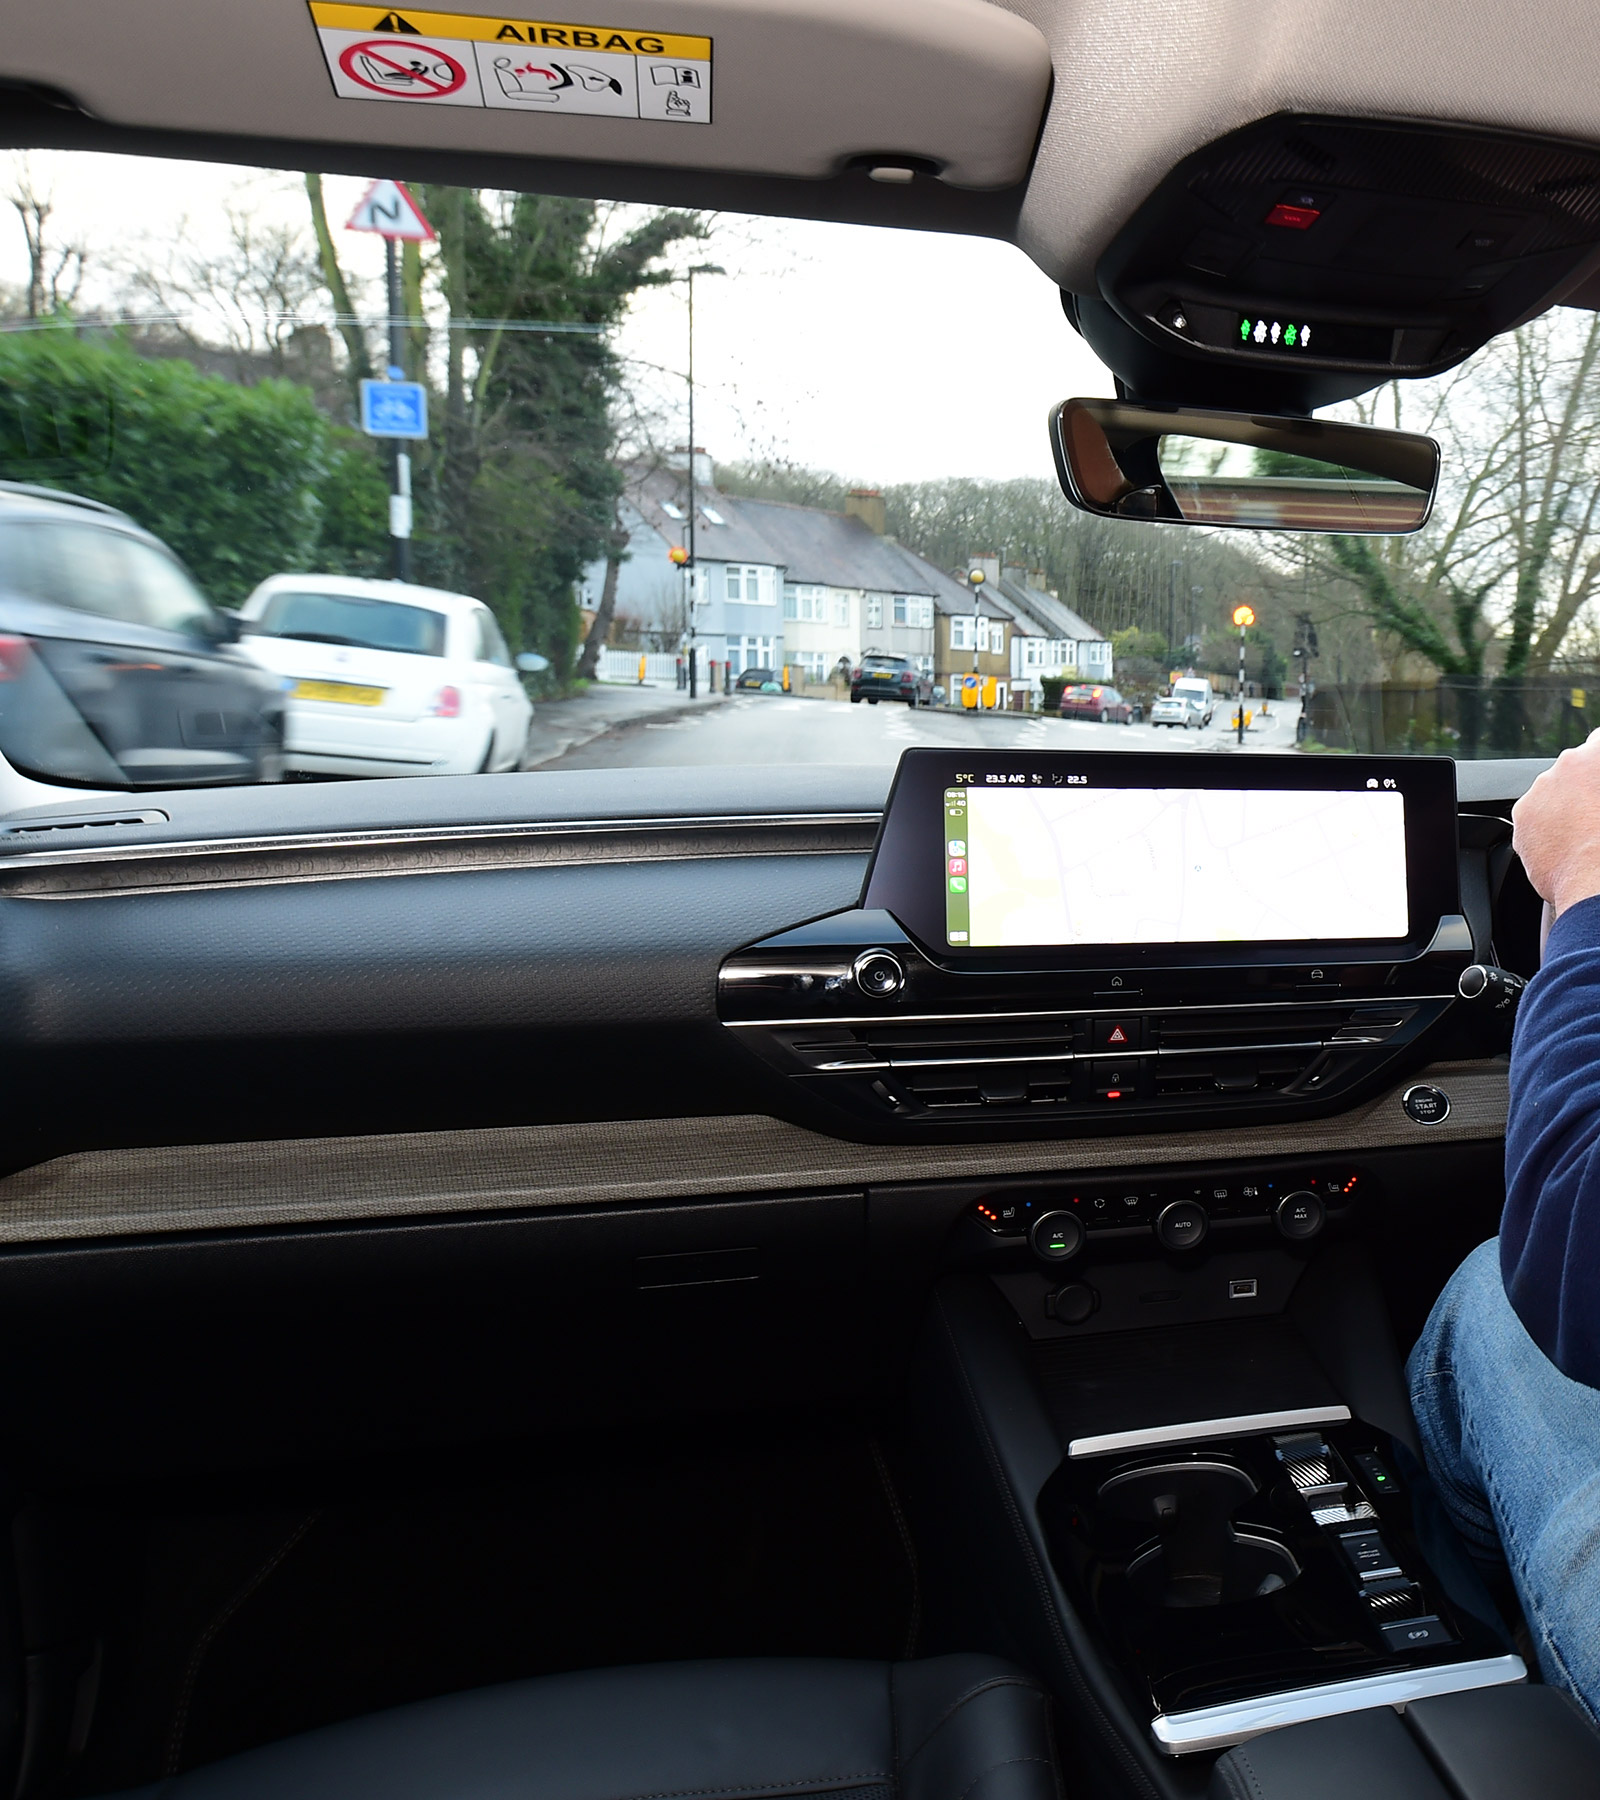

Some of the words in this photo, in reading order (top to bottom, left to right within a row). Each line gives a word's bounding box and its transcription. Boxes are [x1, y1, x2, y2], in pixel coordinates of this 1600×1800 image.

[496, 24, 665, 54] AIRBAG
[955, 773, 974, 783] 5°C
[985, 774, 1006, 784] 23.5
[1008, 774, 1026, 784] A/C
[1067, 775, 1088, 785] 22.5
[1415, 1102, 1437, 1110] START
[1174, 1221, 1192, 1229] AUTO
[1052, 1232, 1064, 1240] A/C
